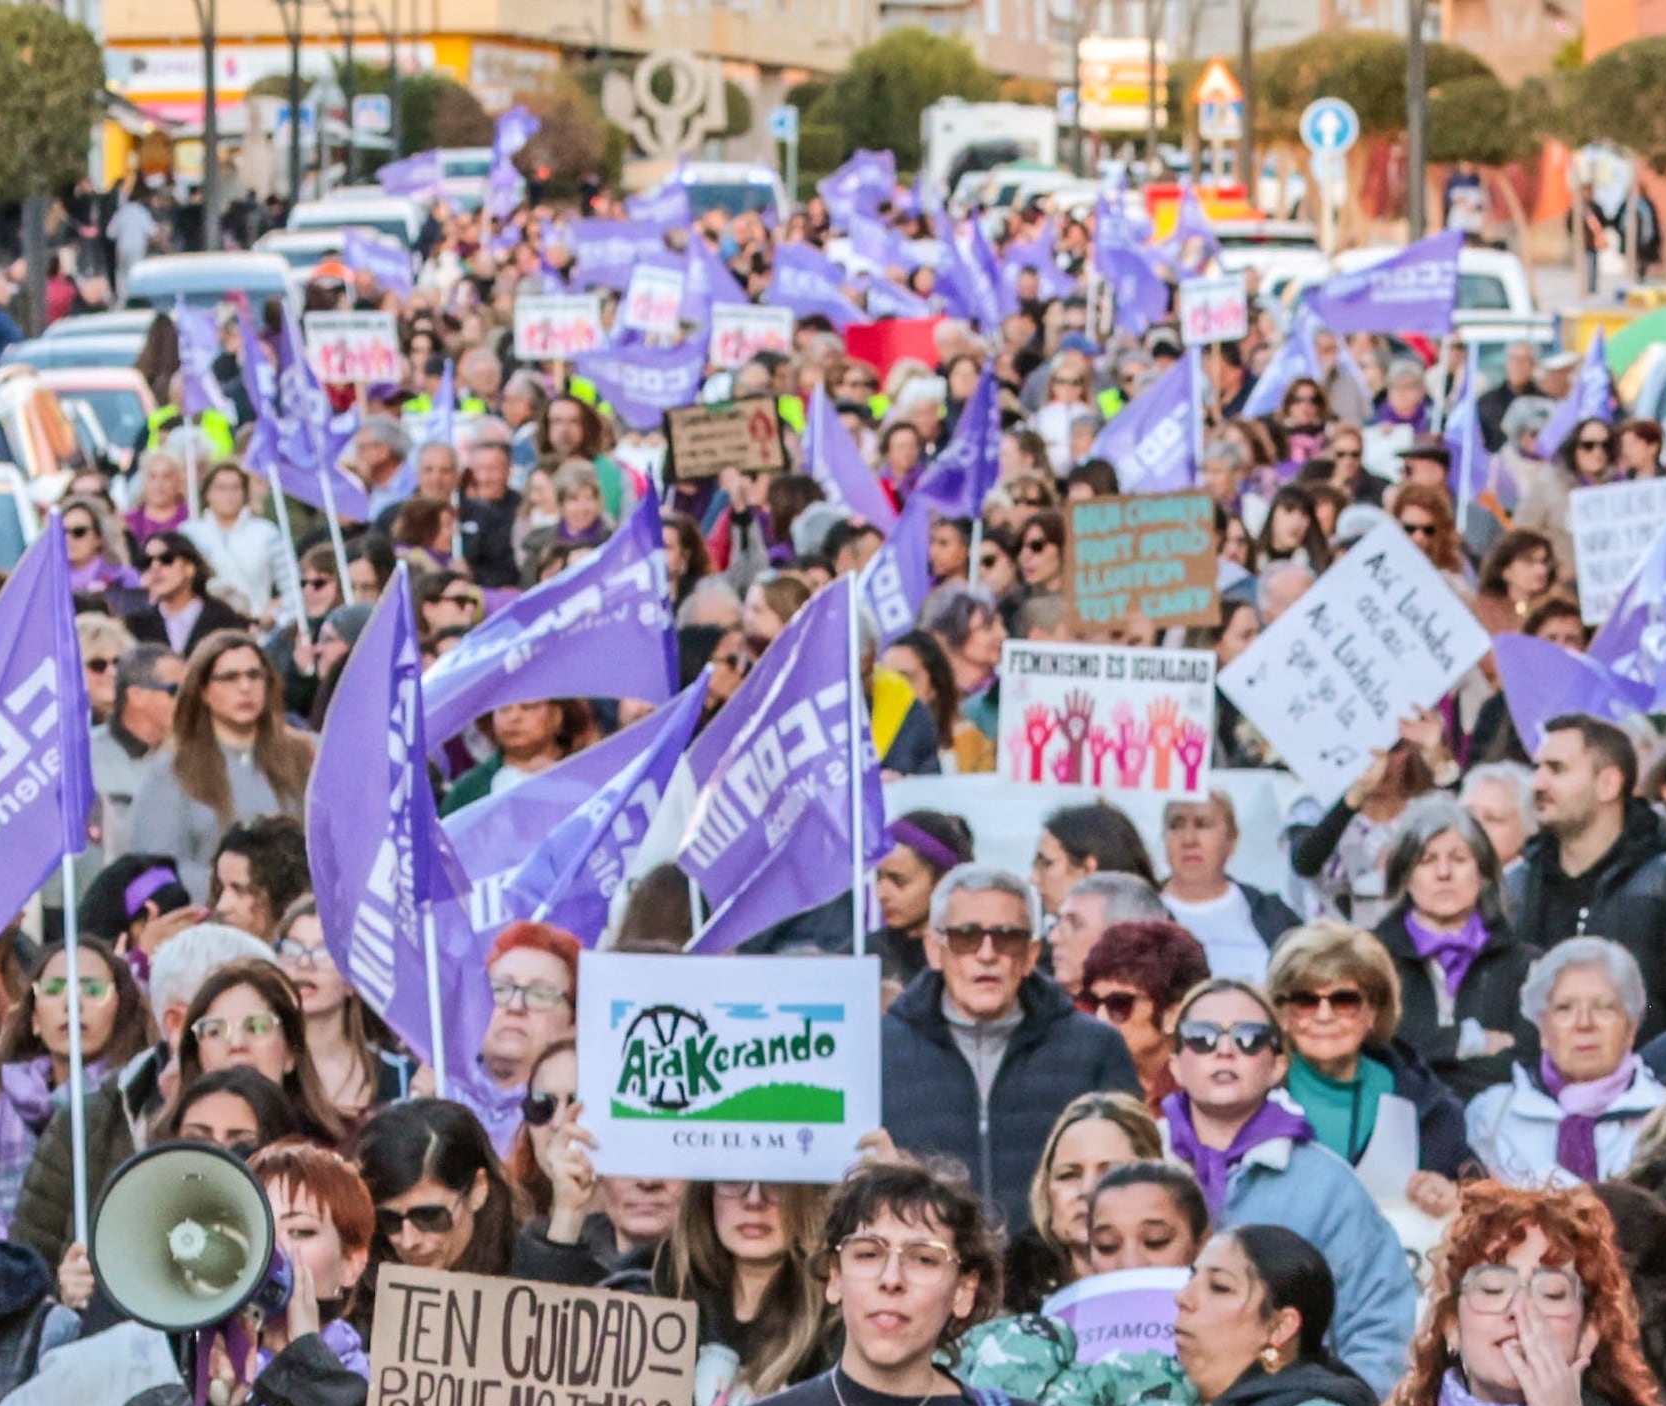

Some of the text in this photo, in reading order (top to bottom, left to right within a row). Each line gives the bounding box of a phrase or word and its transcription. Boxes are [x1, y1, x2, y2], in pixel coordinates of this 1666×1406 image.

[1009, 651, 1209, 683] FEMINISMO ES IGUALDAD
[389, 1282, 482, 1367] TEN
[1085, 1321, 1176, 1345] STAMOS
